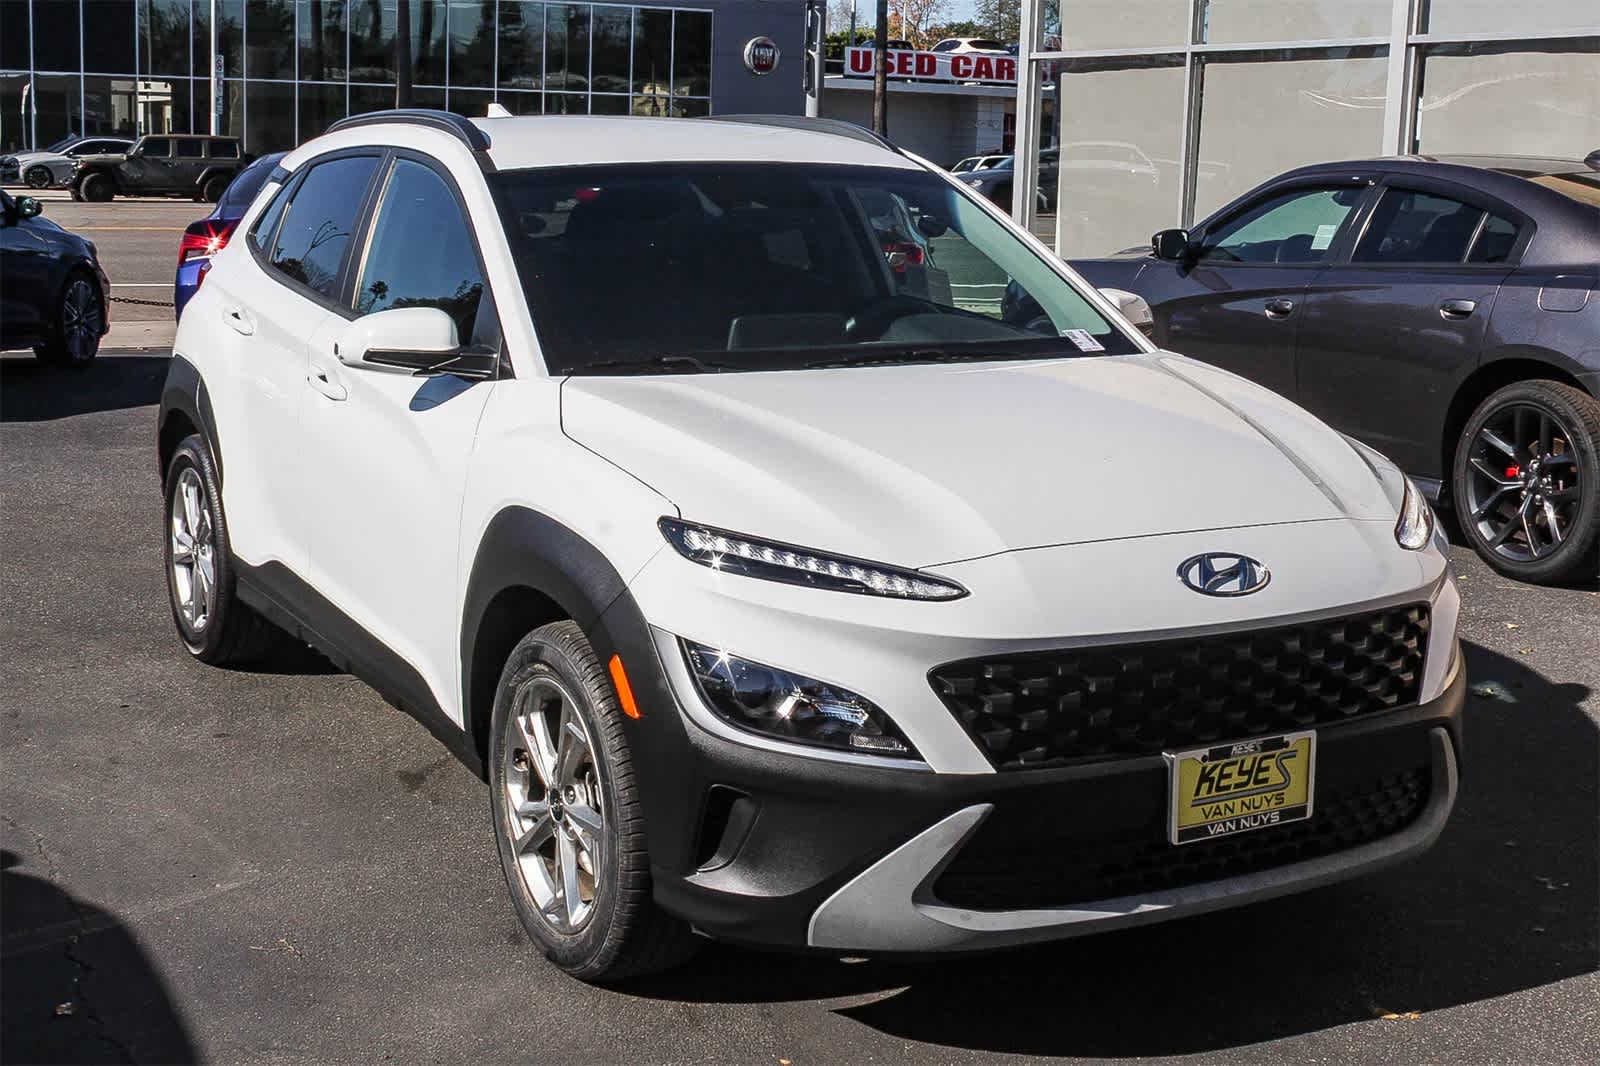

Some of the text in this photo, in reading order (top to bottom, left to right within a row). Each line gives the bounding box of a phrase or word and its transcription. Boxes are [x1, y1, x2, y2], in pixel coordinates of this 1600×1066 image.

[850, 49, 937, 76] USED
[1192, 749, 1298, 801] KEYES
[1201, 792, 1285, 819] VAN NUYS
[1207, 811, 1280, 835] VAN NUYS
